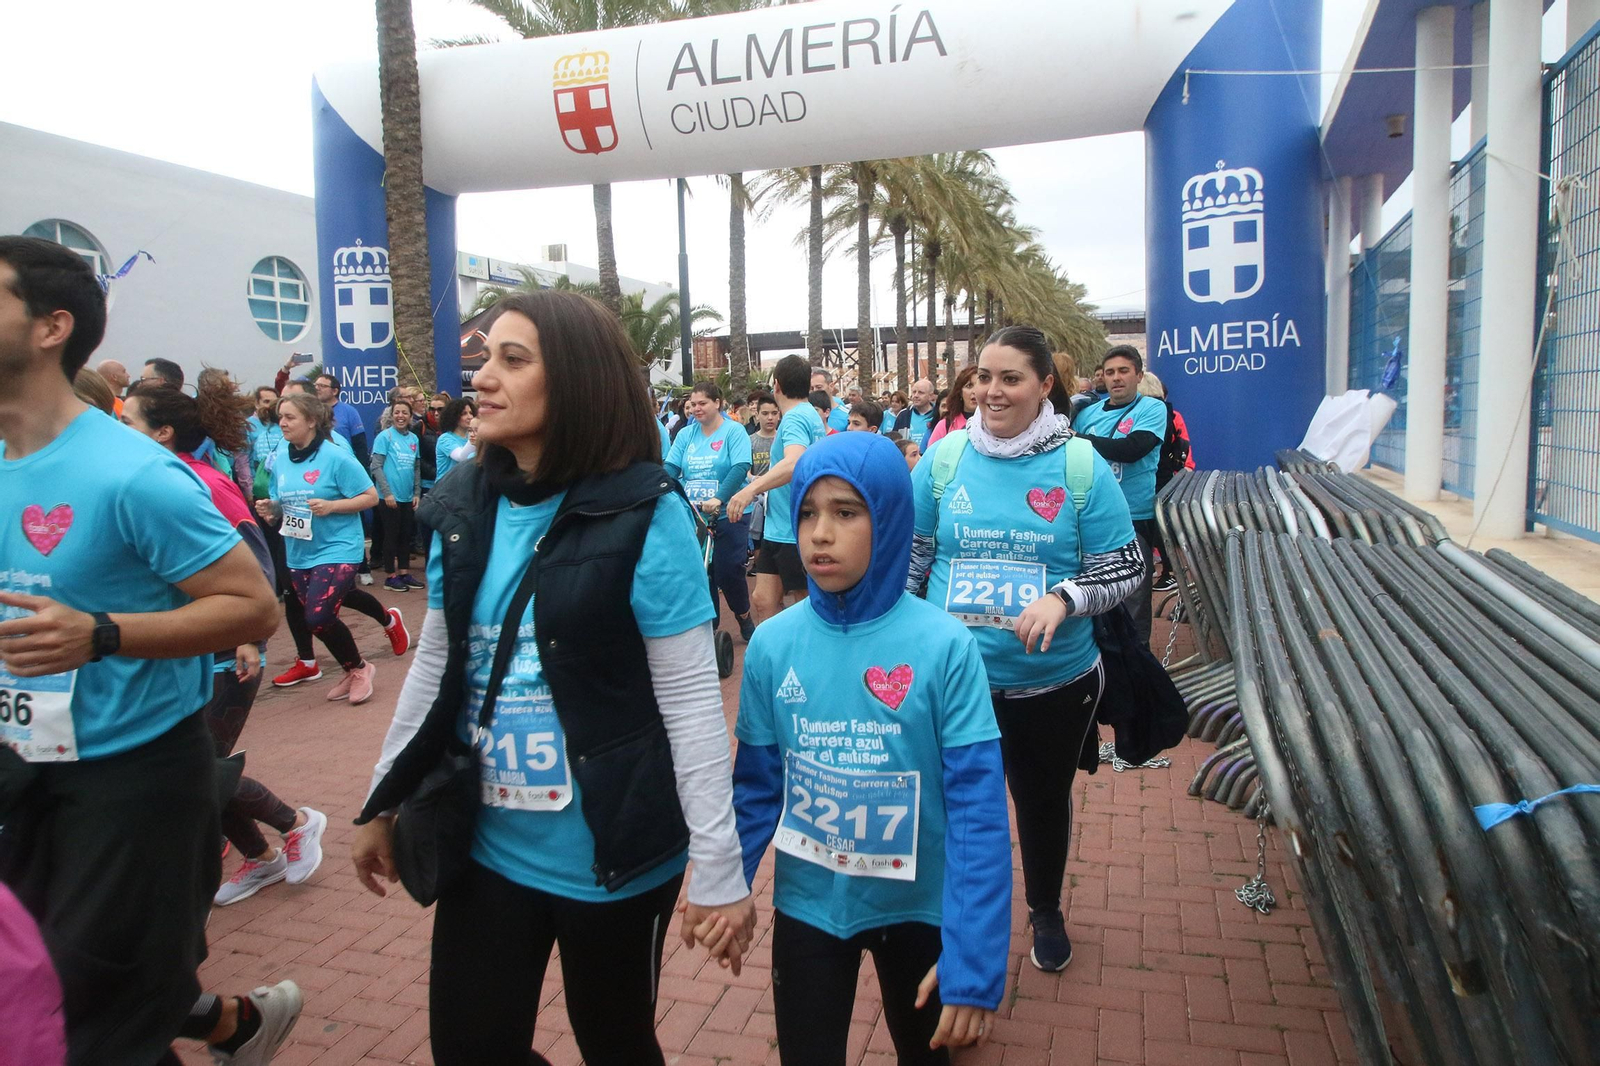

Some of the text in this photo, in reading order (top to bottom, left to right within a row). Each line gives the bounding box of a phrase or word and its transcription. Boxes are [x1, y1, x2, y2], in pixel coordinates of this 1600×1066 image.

[666, 4, 948, 91] ALMERÍA
[670, 90, 807, 134] CIUDAD
[1157, 312, 1301, 357] ALMERÍA
[1184, 353, 1266, 375] CIUDAD
[685, 488, 715, 498] 1738
[286, 515, 305, 529] 250
[963, 526, 1006, 539] Runner
[1010, 529, 1055, 543] Fashion
[960, 539, 1036, 553] Carrera azul
[960, 550, 1038, 562] por el autismo
[952, 580, 1039, 608] 2219
[984, 606, 1005, 615] JUANA
[776, 687, 806, 698] ALTEA
[791, 713, 902, 735] I Runner Fashion
[798, 733, 884, 751] Carrera azul
[820, 749, 835, 764] el
[838, 749, 889, 765] autismo
[804, 777, 812, 789] el
[813, 782, 848, 799] autismo
[819, 771, 847, 786] Fashion
[853, 780, 889, 788] Carrera
[891, 779, 908, 788] azul
[791, 785, 908, 841] 2217
[826, 834, 855, 852] CESAR
